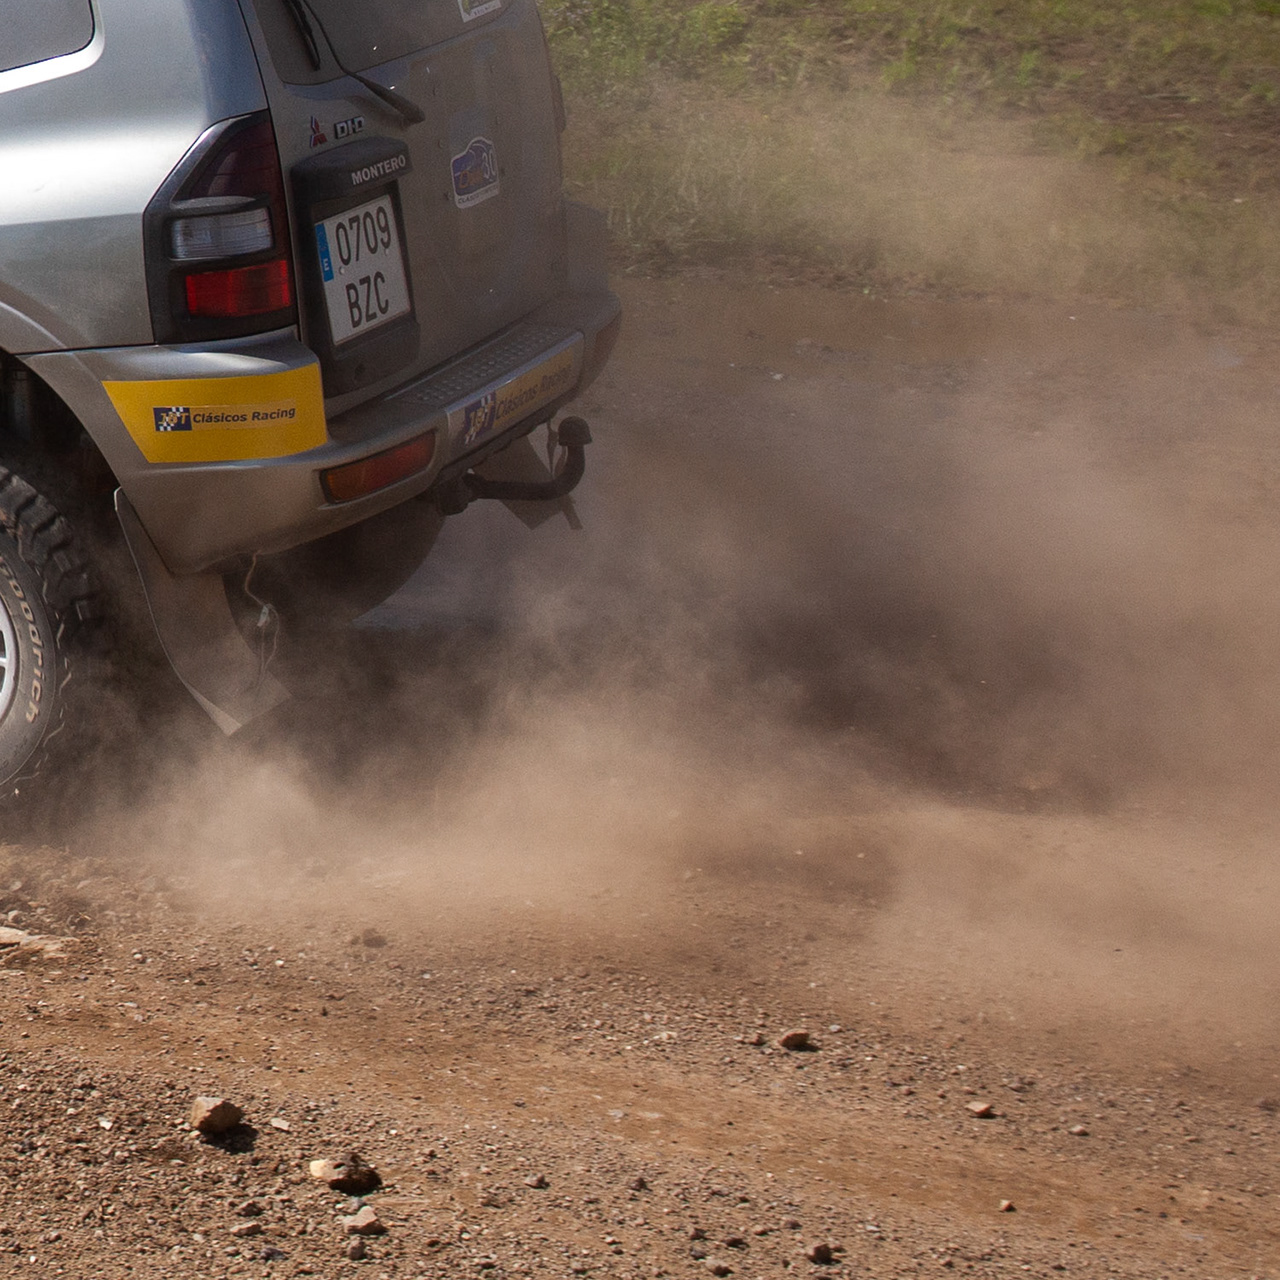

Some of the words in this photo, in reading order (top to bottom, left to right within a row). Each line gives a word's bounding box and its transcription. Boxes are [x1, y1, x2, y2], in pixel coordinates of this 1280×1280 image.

[351, 154, 406, 185] MONTERO
[335, 205, 392, 266] 0709
[345, 271, 389, 328] BZC
[193, 412, 247, 424] Clásicos
[251, 407, 296, 421] Racing
